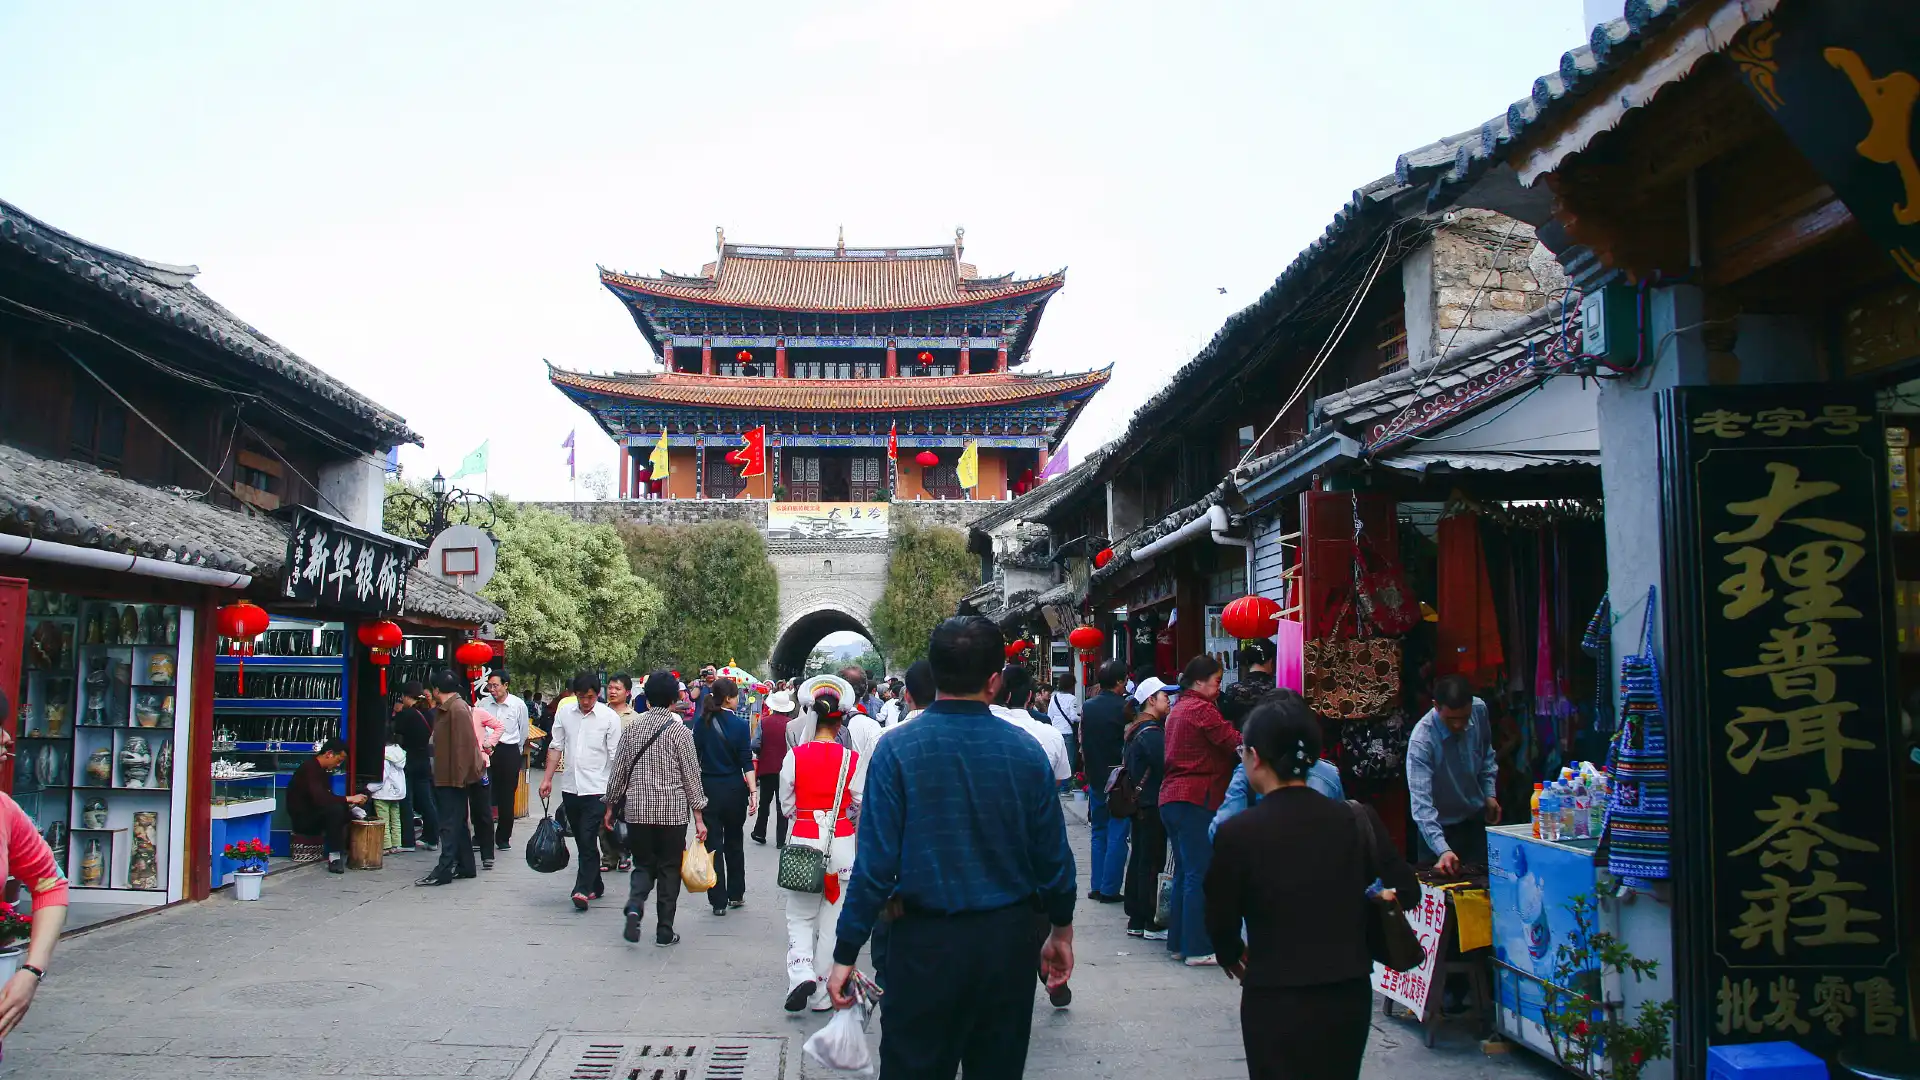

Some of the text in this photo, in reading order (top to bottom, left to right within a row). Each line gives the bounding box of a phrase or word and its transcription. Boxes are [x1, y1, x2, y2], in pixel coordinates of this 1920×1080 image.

[1692, 406, 1874, 438] 老字号
[303, 526, 399, 611] 新华银饰
[1714, 974, 1906, 1036] 批发零售
